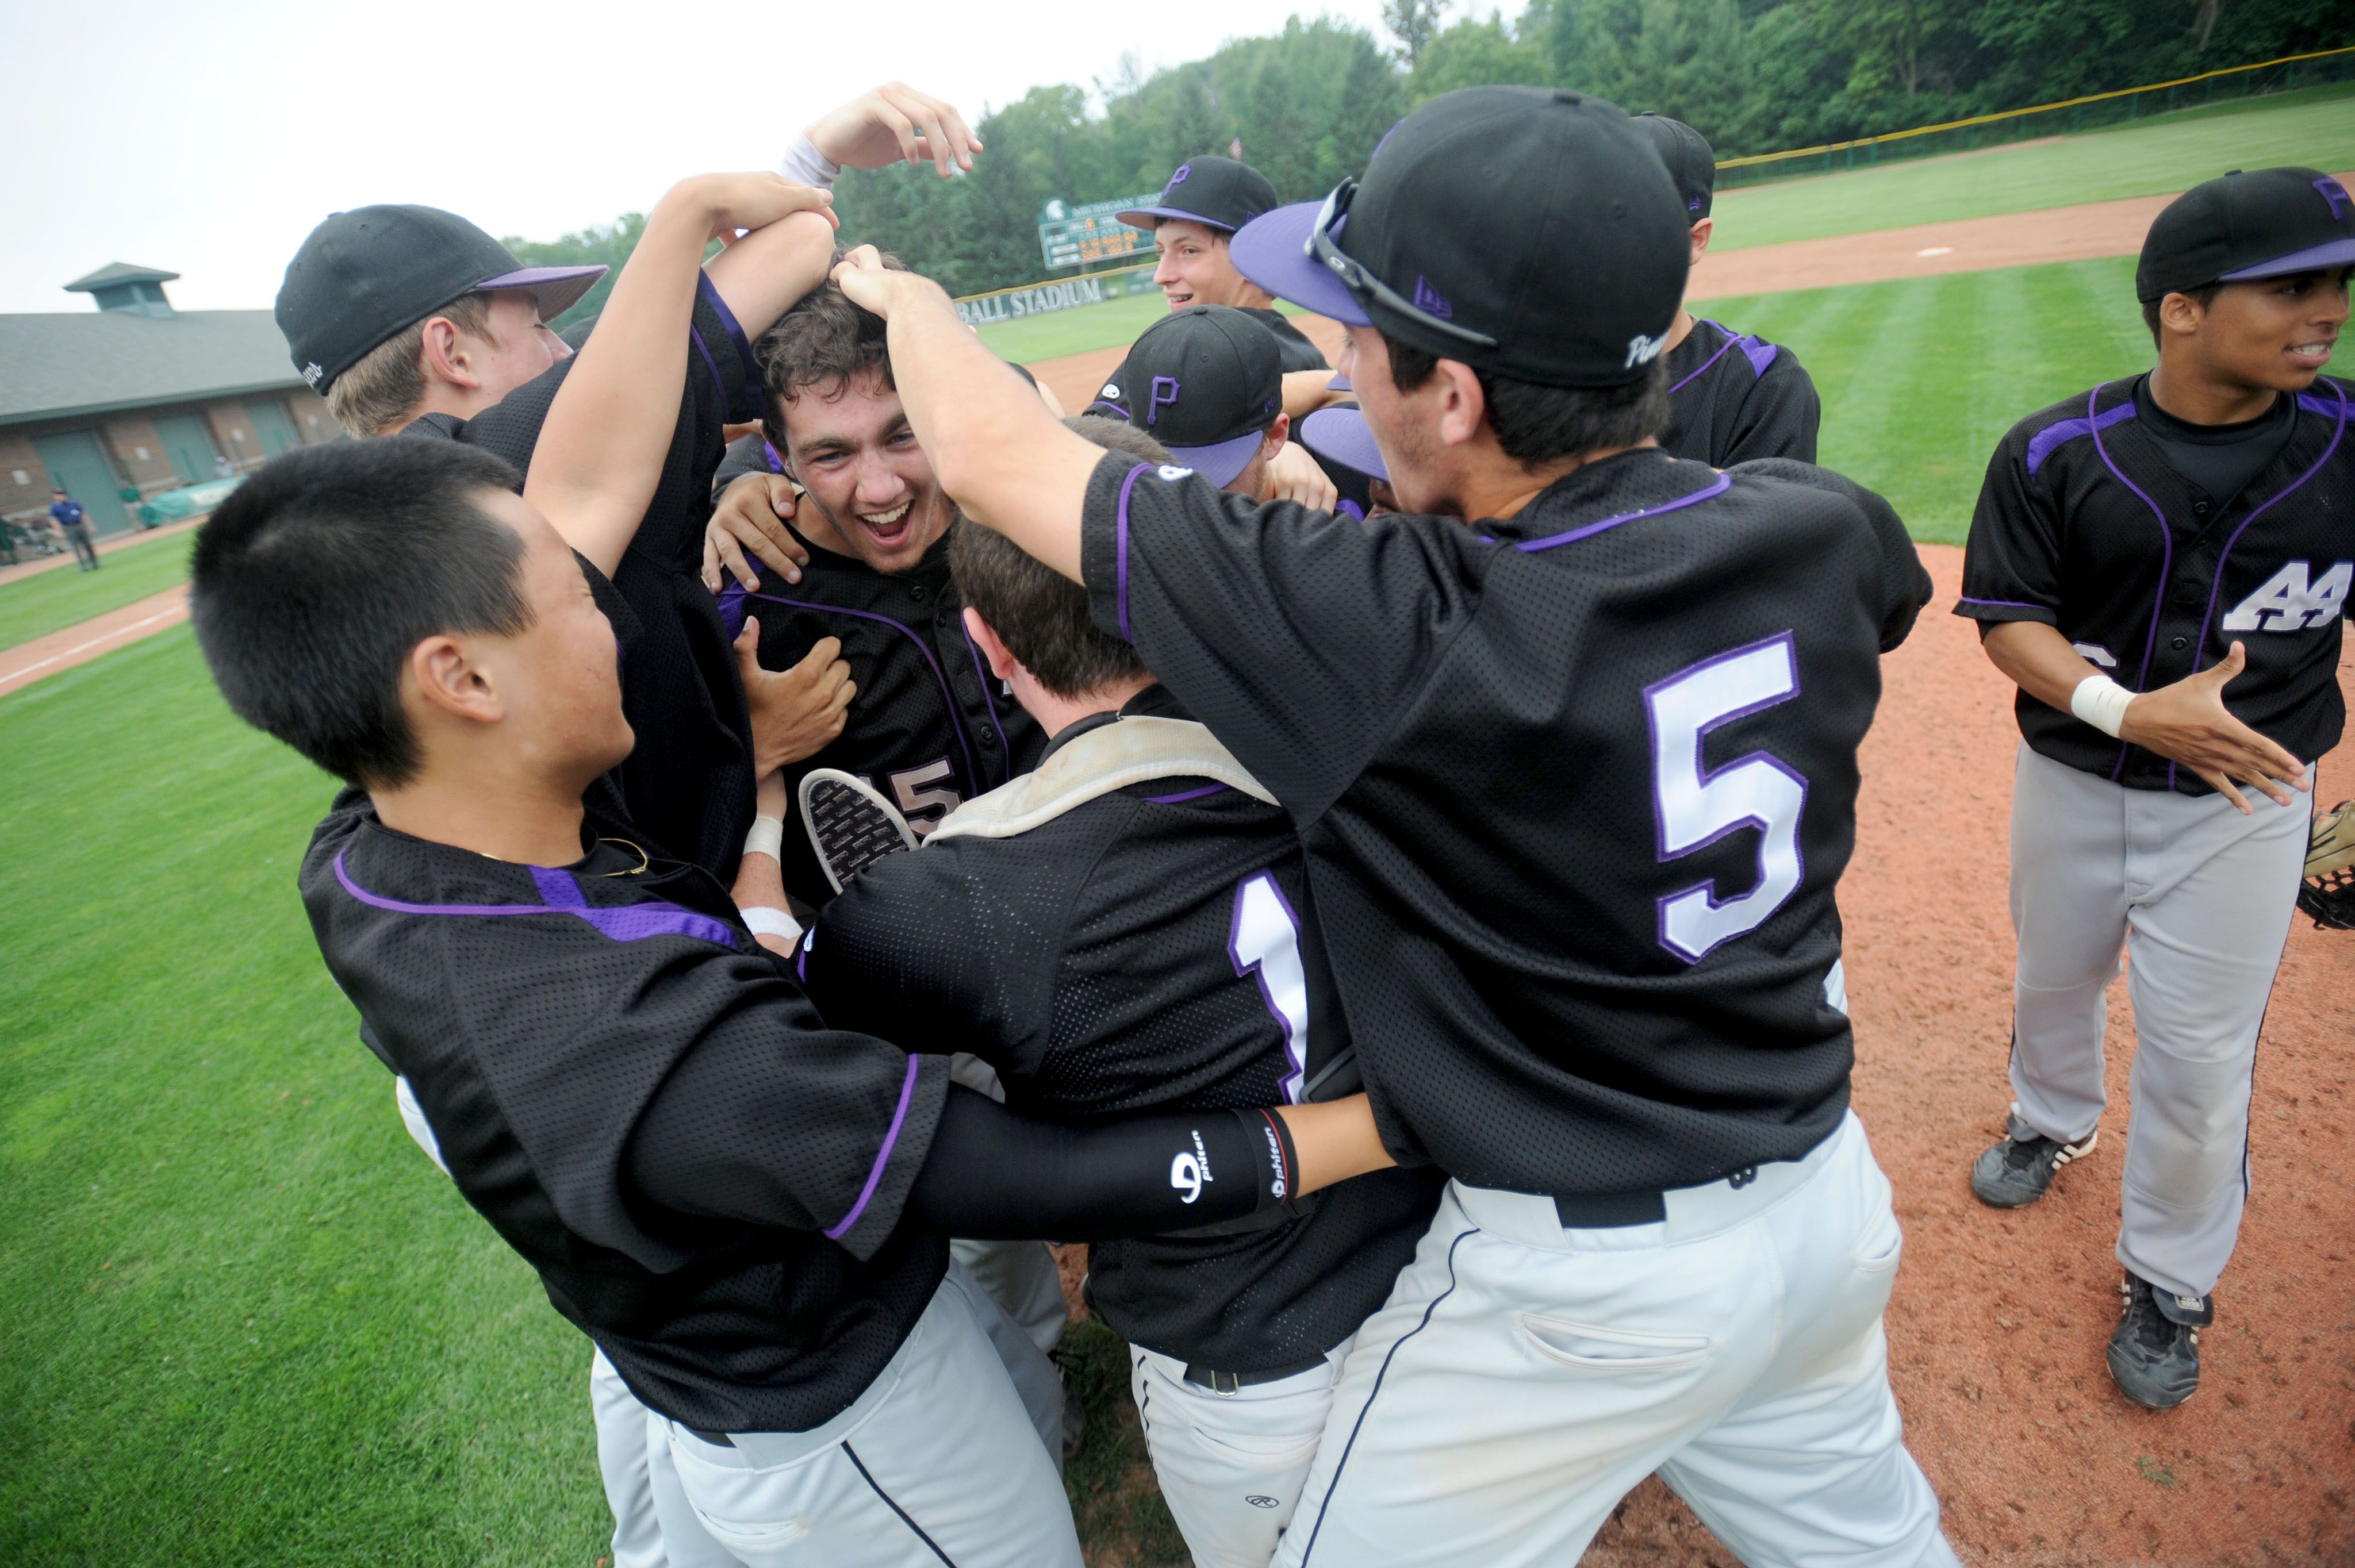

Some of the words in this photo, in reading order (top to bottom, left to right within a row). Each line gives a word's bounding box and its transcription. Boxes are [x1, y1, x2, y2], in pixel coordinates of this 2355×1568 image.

[1163, 164, 1192, 198] P
[1010, 278, 1102, 317] STADIUM
[1147, 375, 1180, 425] P
[2222, 561, 2354, 632] AA
[1641, 629, 1809, 966] 5
[1191, 1129, 1213, 1182] phiten
[1264, 1126, 1285, 1180] phiten
